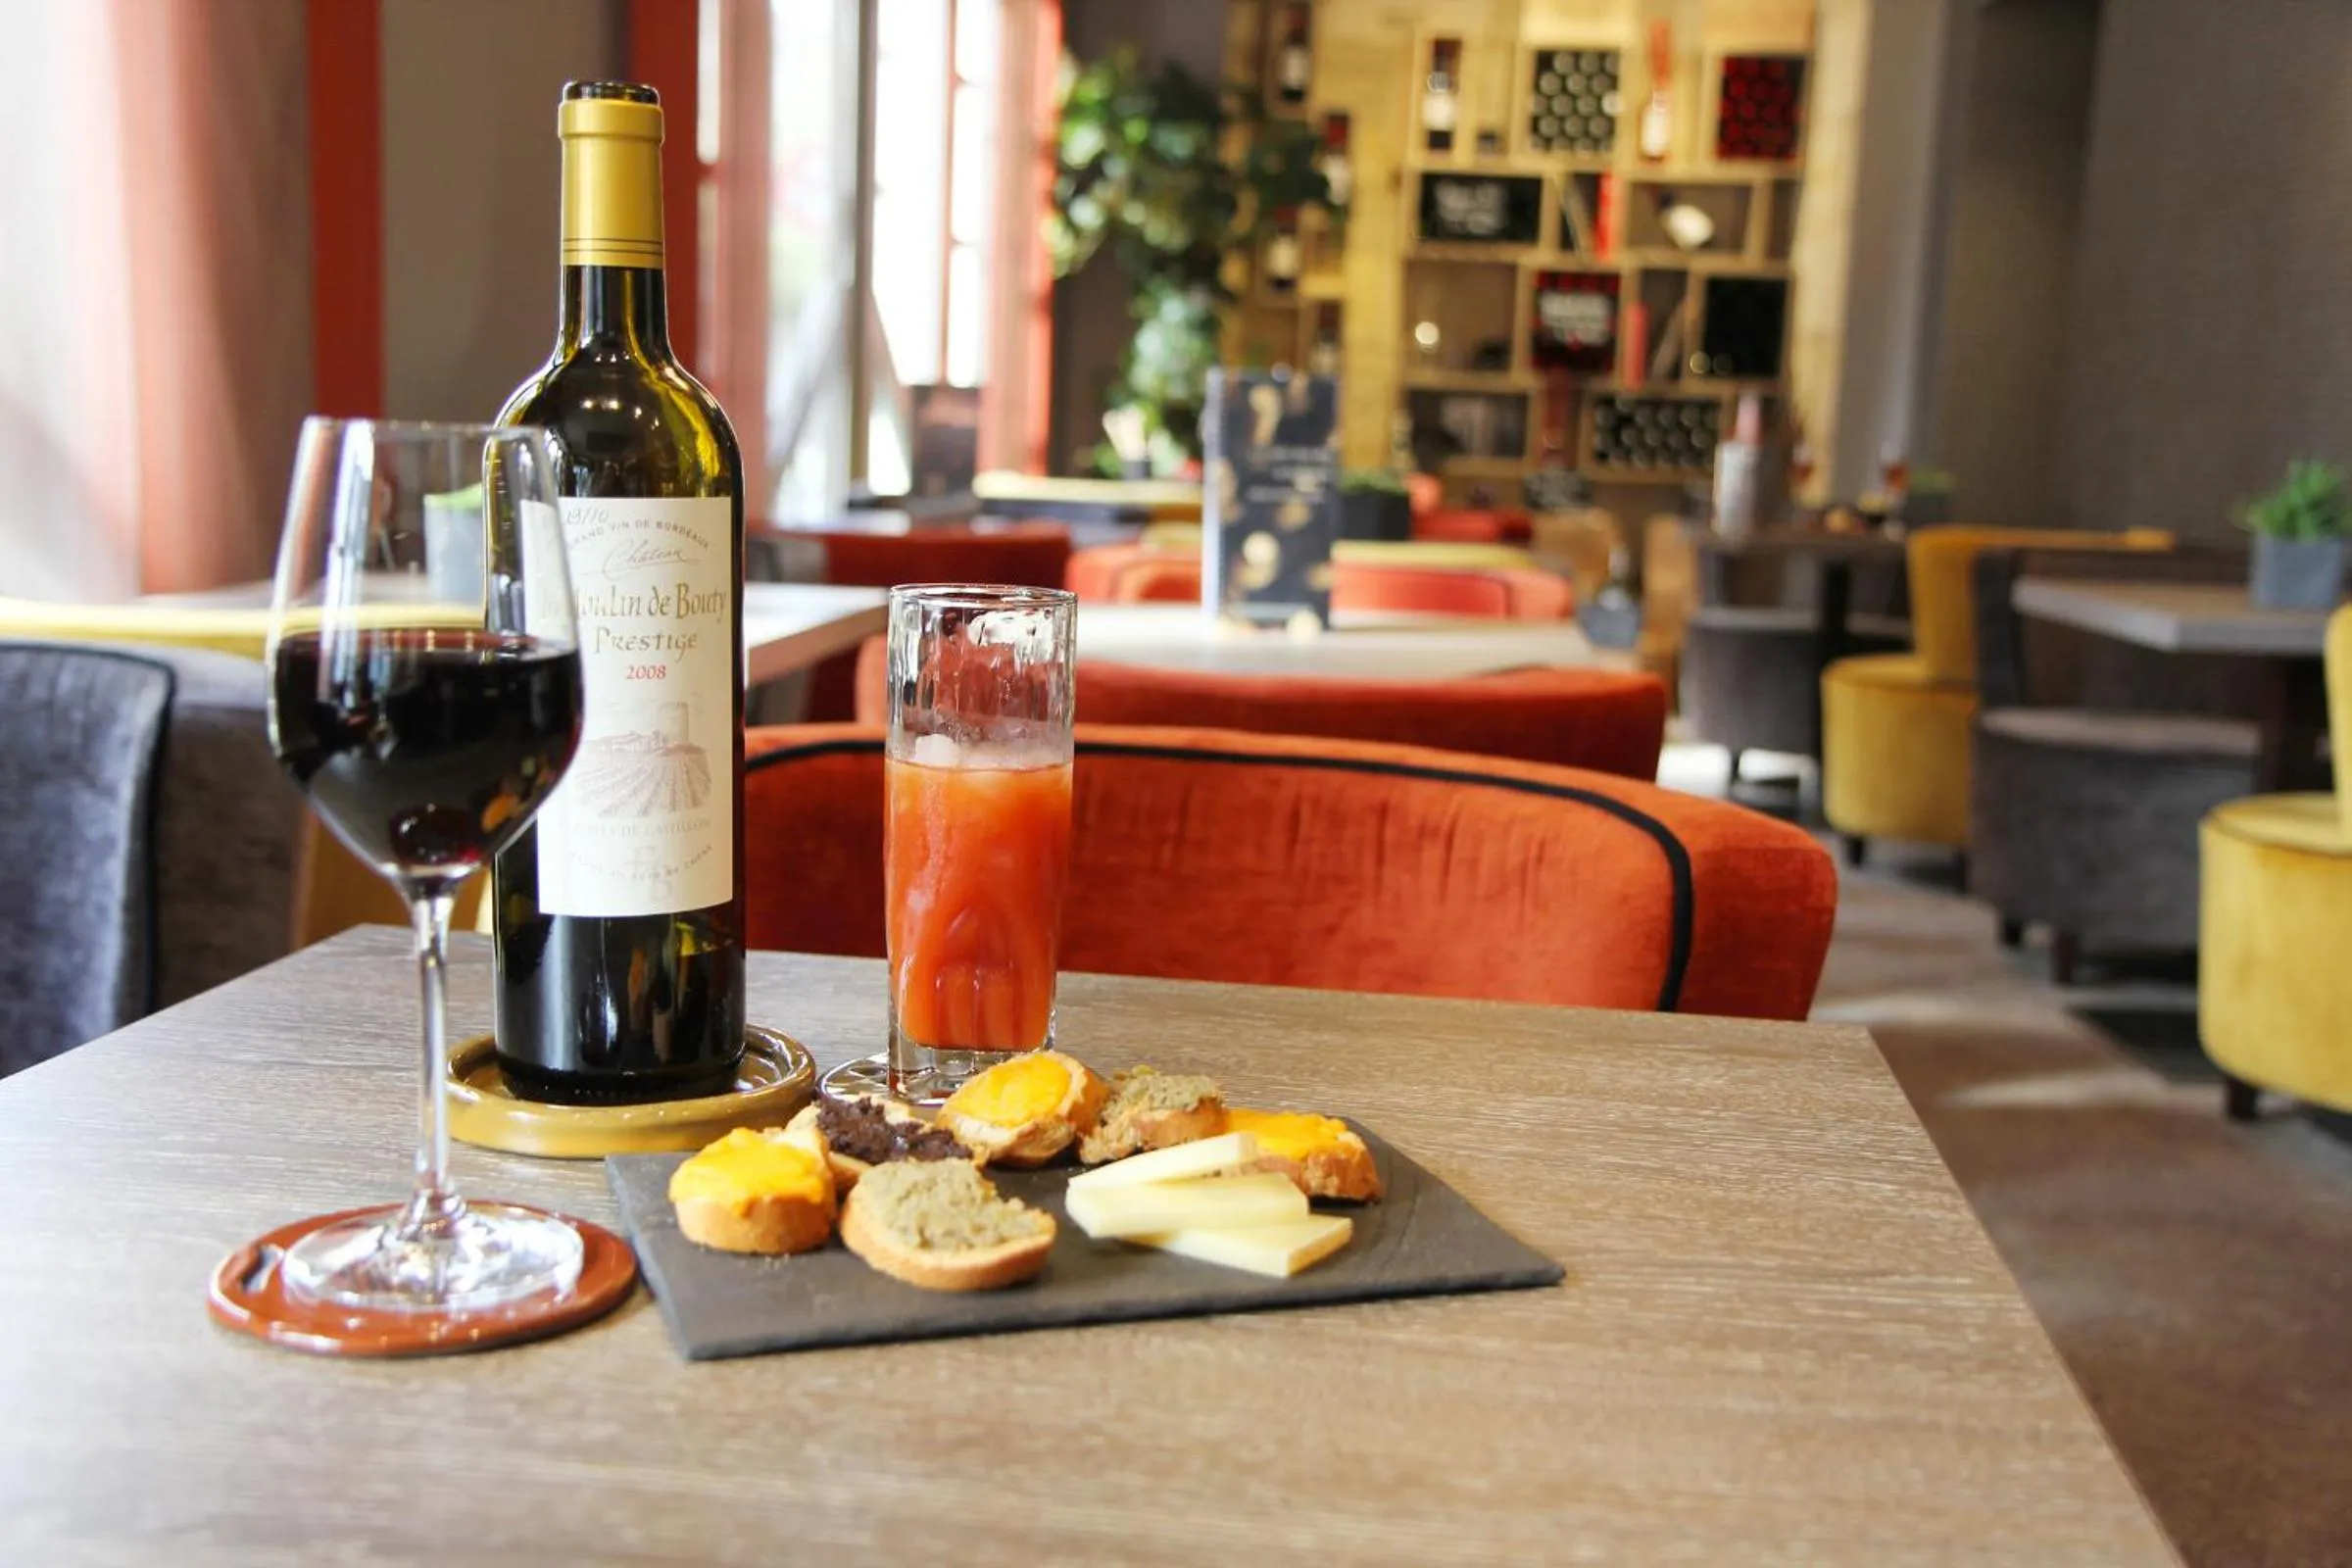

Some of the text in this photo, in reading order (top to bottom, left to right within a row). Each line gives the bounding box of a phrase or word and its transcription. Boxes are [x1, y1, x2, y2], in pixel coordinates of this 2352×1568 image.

[635, 518, 651, 528] DE
[656, 520, 709, 550] BORDEAUX
[648, 585, 672, 618] de
[626, 664, 667, 680] 2008
